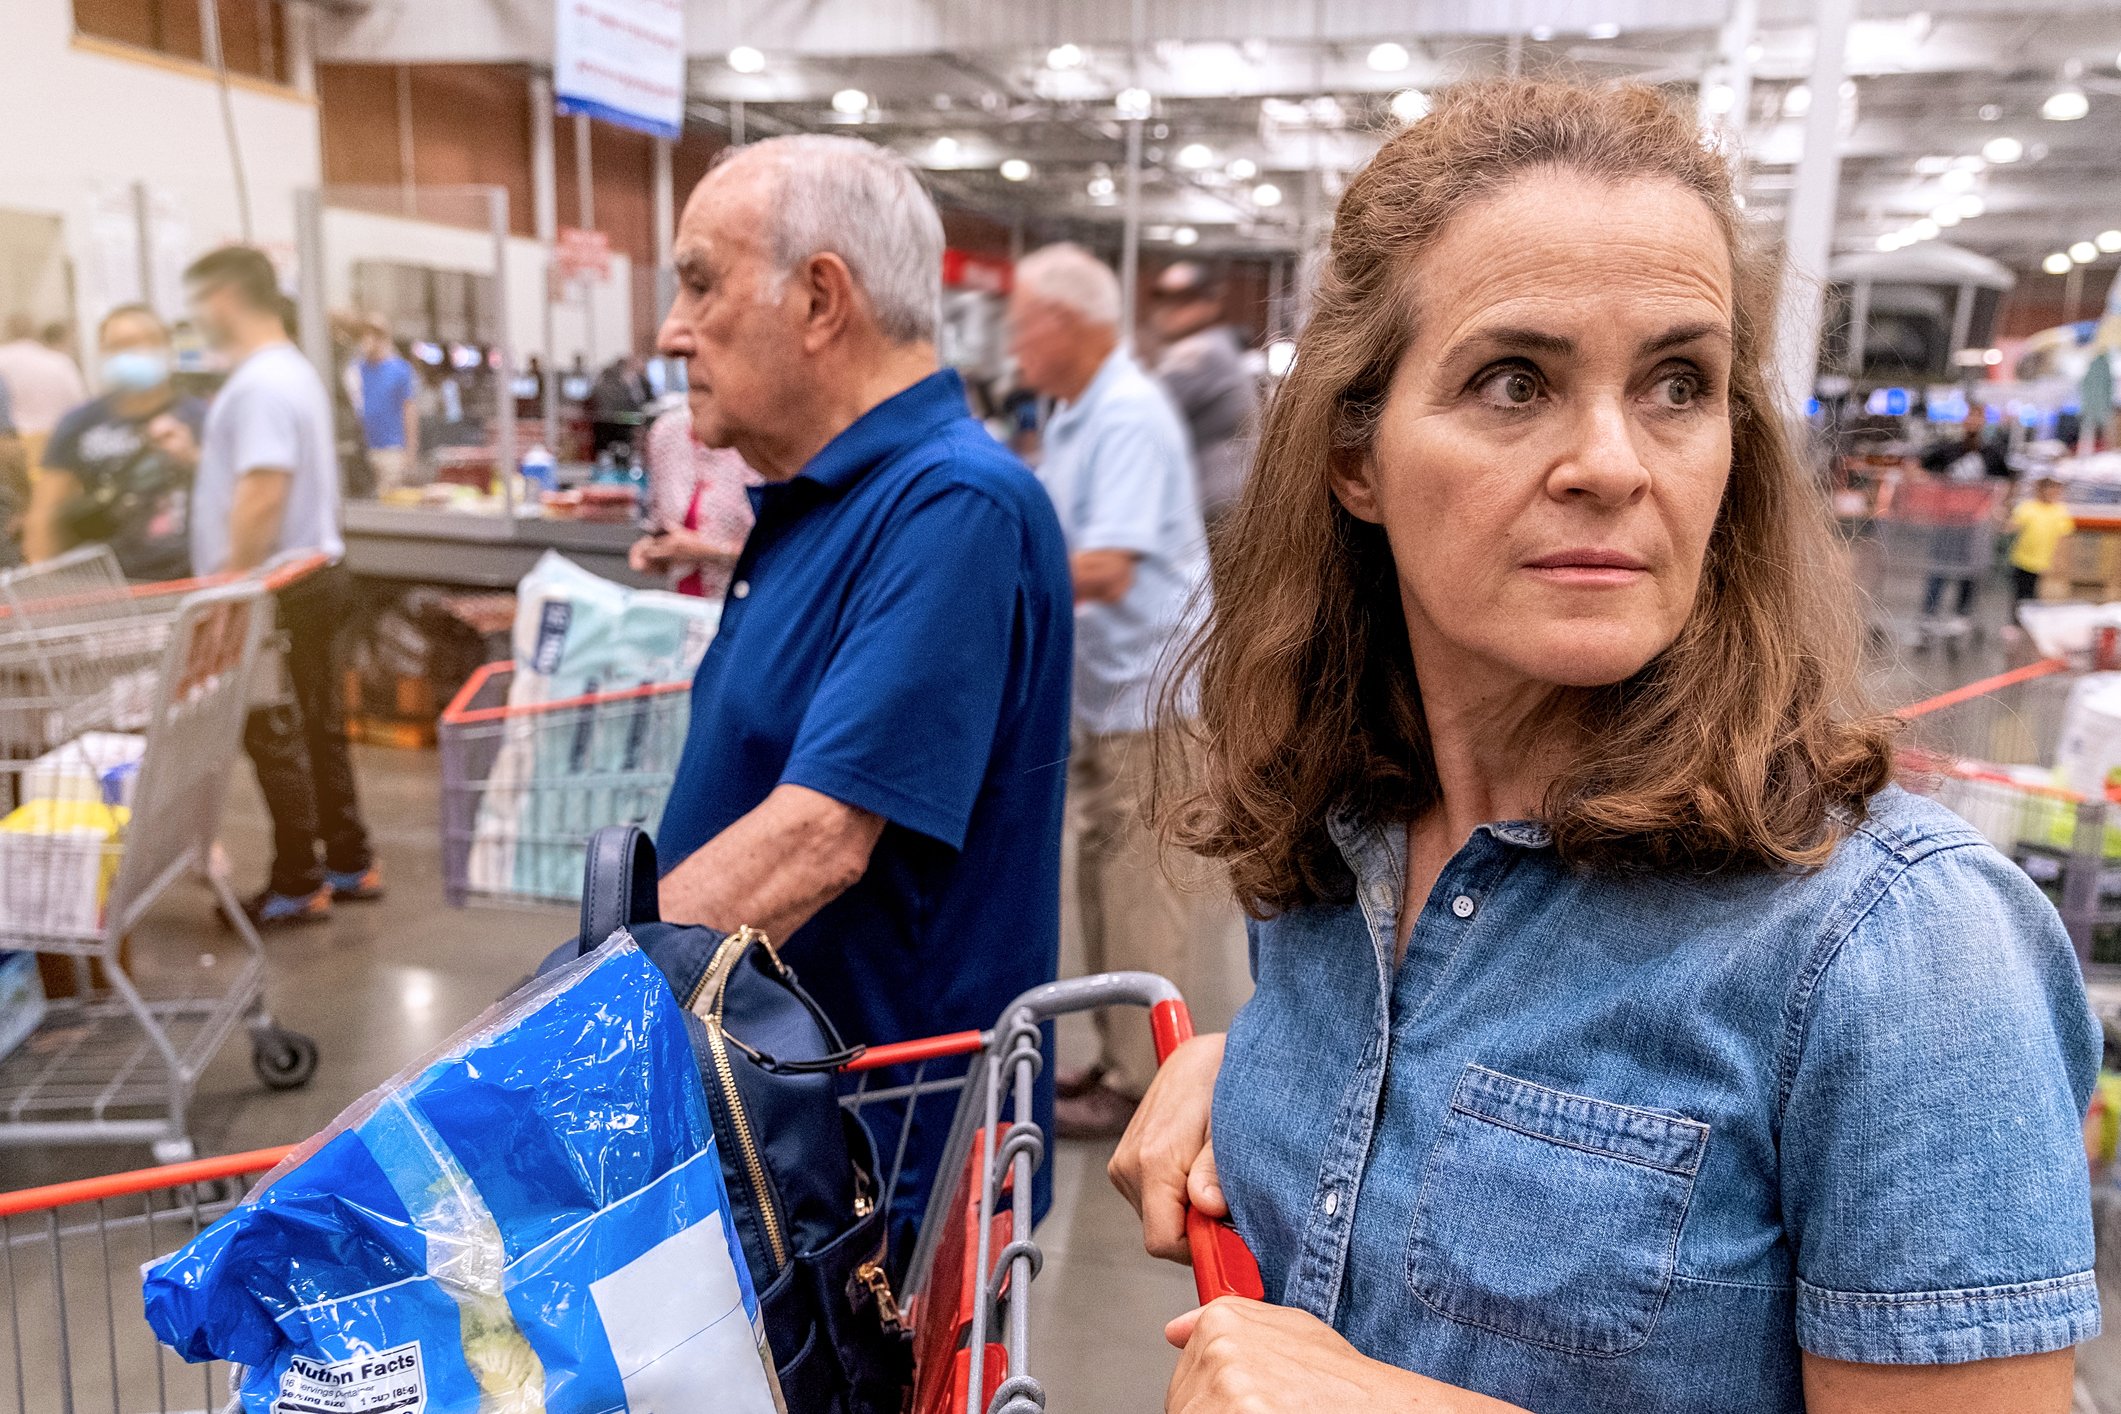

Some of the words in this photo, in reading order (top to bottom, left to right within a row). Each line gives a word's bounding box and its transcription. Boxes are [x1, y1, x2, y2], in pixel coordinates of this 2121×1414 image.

[361, 1355, 415, 1380] Facts
[285, 1378, 296, 1388] 16
[300, 1382, 334, 1398] ervings
[324, 1399, 346, 1408] size
